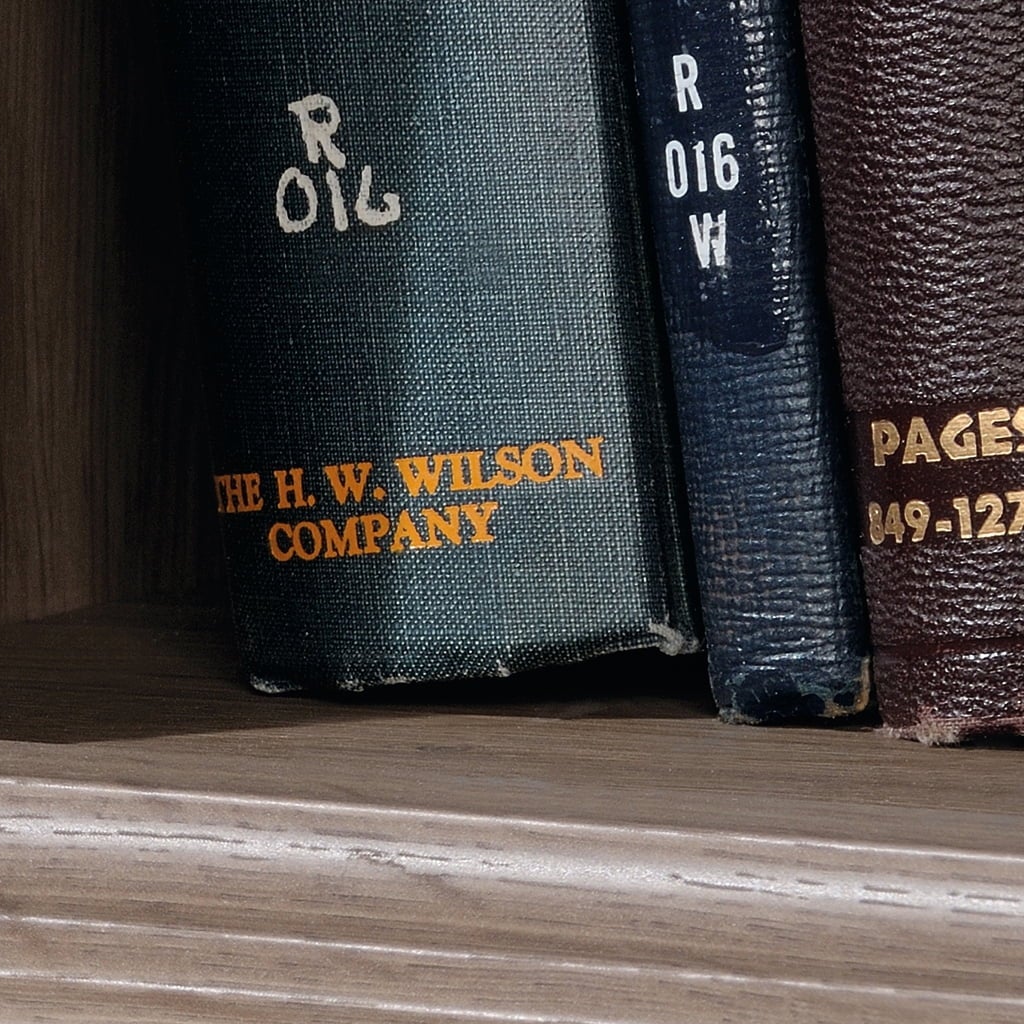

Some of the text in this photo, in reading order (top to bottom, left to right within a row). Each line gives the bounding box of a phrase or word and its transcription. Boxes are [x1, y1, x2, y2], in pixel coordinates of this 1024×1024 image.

[672, 53, 703, 112] R
[287, 93, 346, 169] R
[665, 132, 739, 198] 016
[276, 165, 401, 233] 016
[275, 467, 316, 510] H.
[324, 461, 387, 502] W.
[394, 436, 605, 498] WILSON
[268, 501, 498, 562] COMPANY
